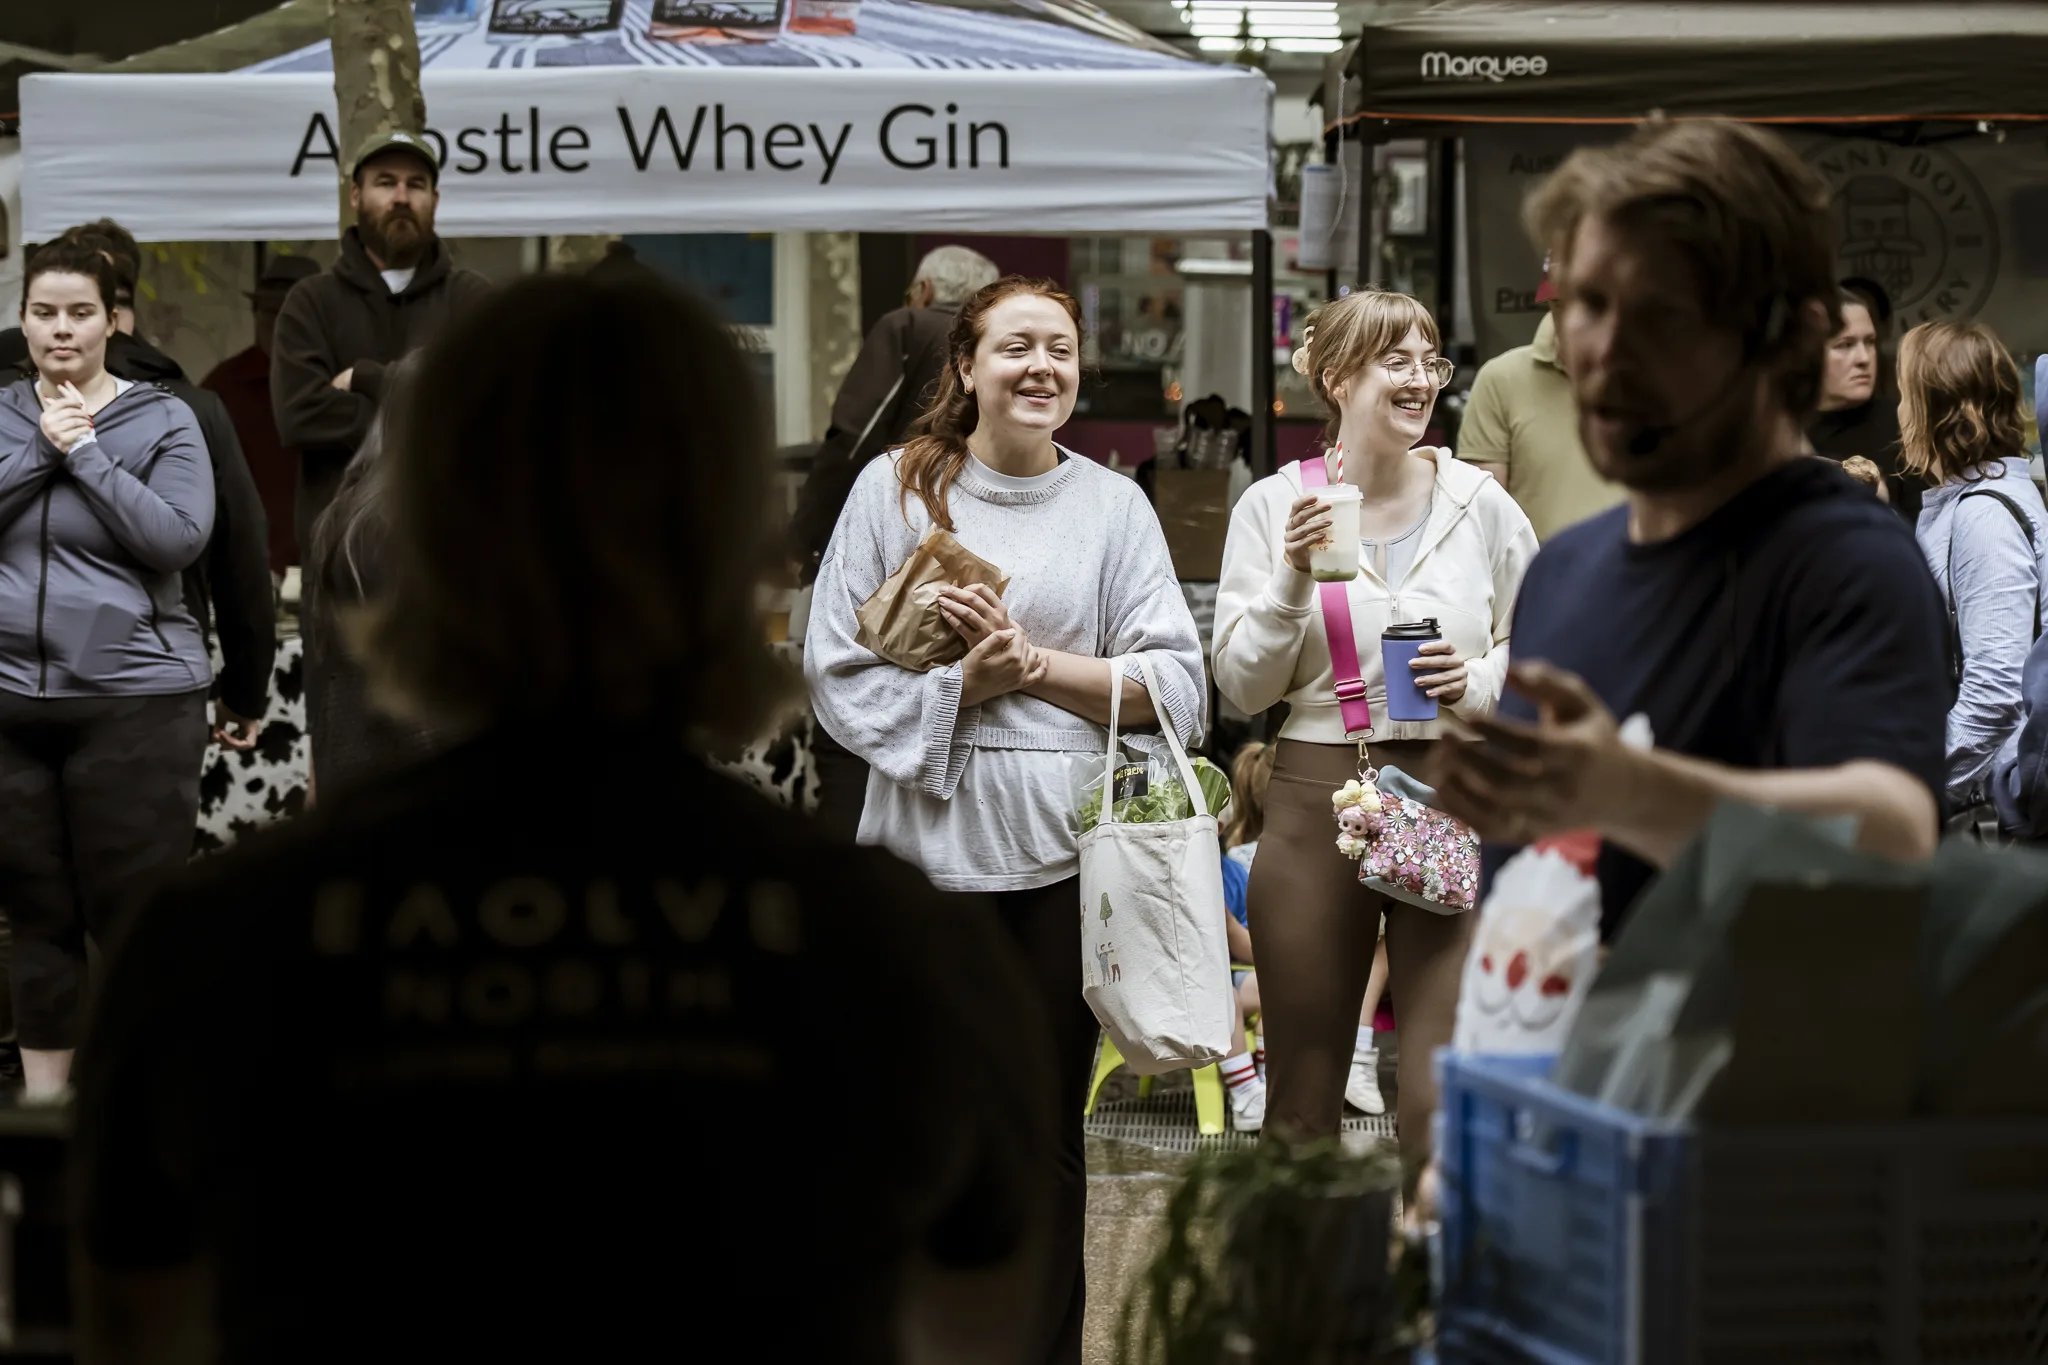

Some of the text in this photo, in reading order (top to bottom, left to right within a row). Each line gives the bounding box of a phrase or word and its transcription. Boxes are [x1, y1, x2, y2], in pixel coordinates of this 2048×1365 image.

[1421, 51, 1549, 82] Marquee
[290, 102, 1010, 185] Astle Whey Gin
